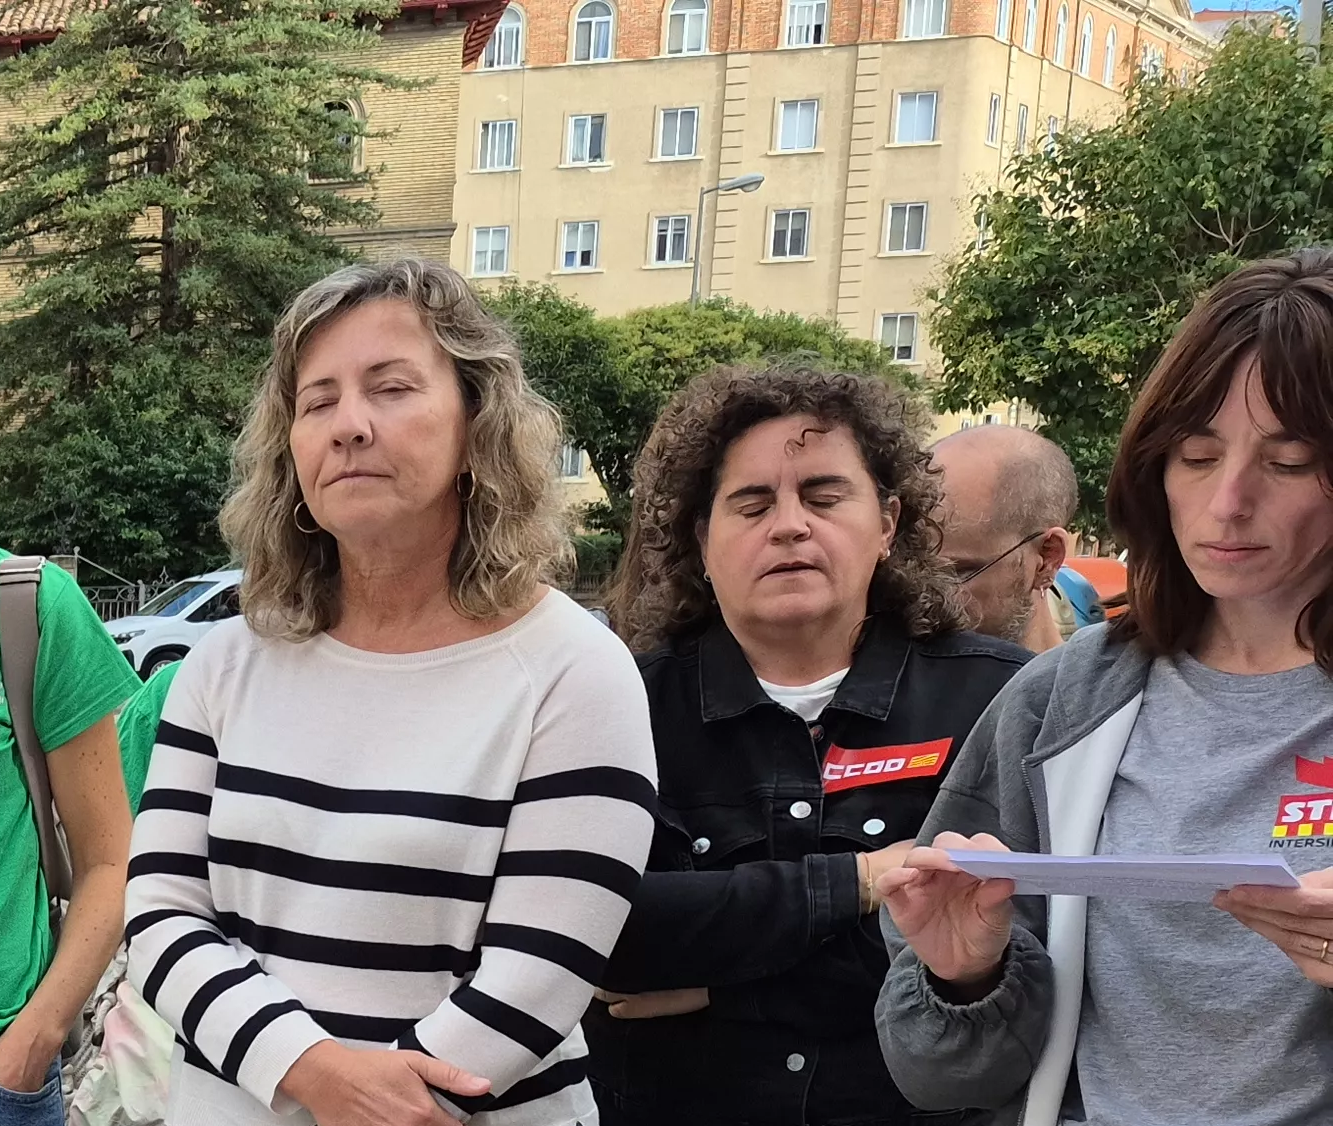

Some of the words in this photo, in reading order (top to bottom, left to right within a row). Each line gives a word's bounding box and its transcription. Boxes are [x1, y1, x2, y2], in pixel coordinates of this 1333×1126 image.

[823, 758, 907, 780] CCOO
[1281, 798, 1333, 823] ST
[1269, 838, 1333, 848] INTERSI
